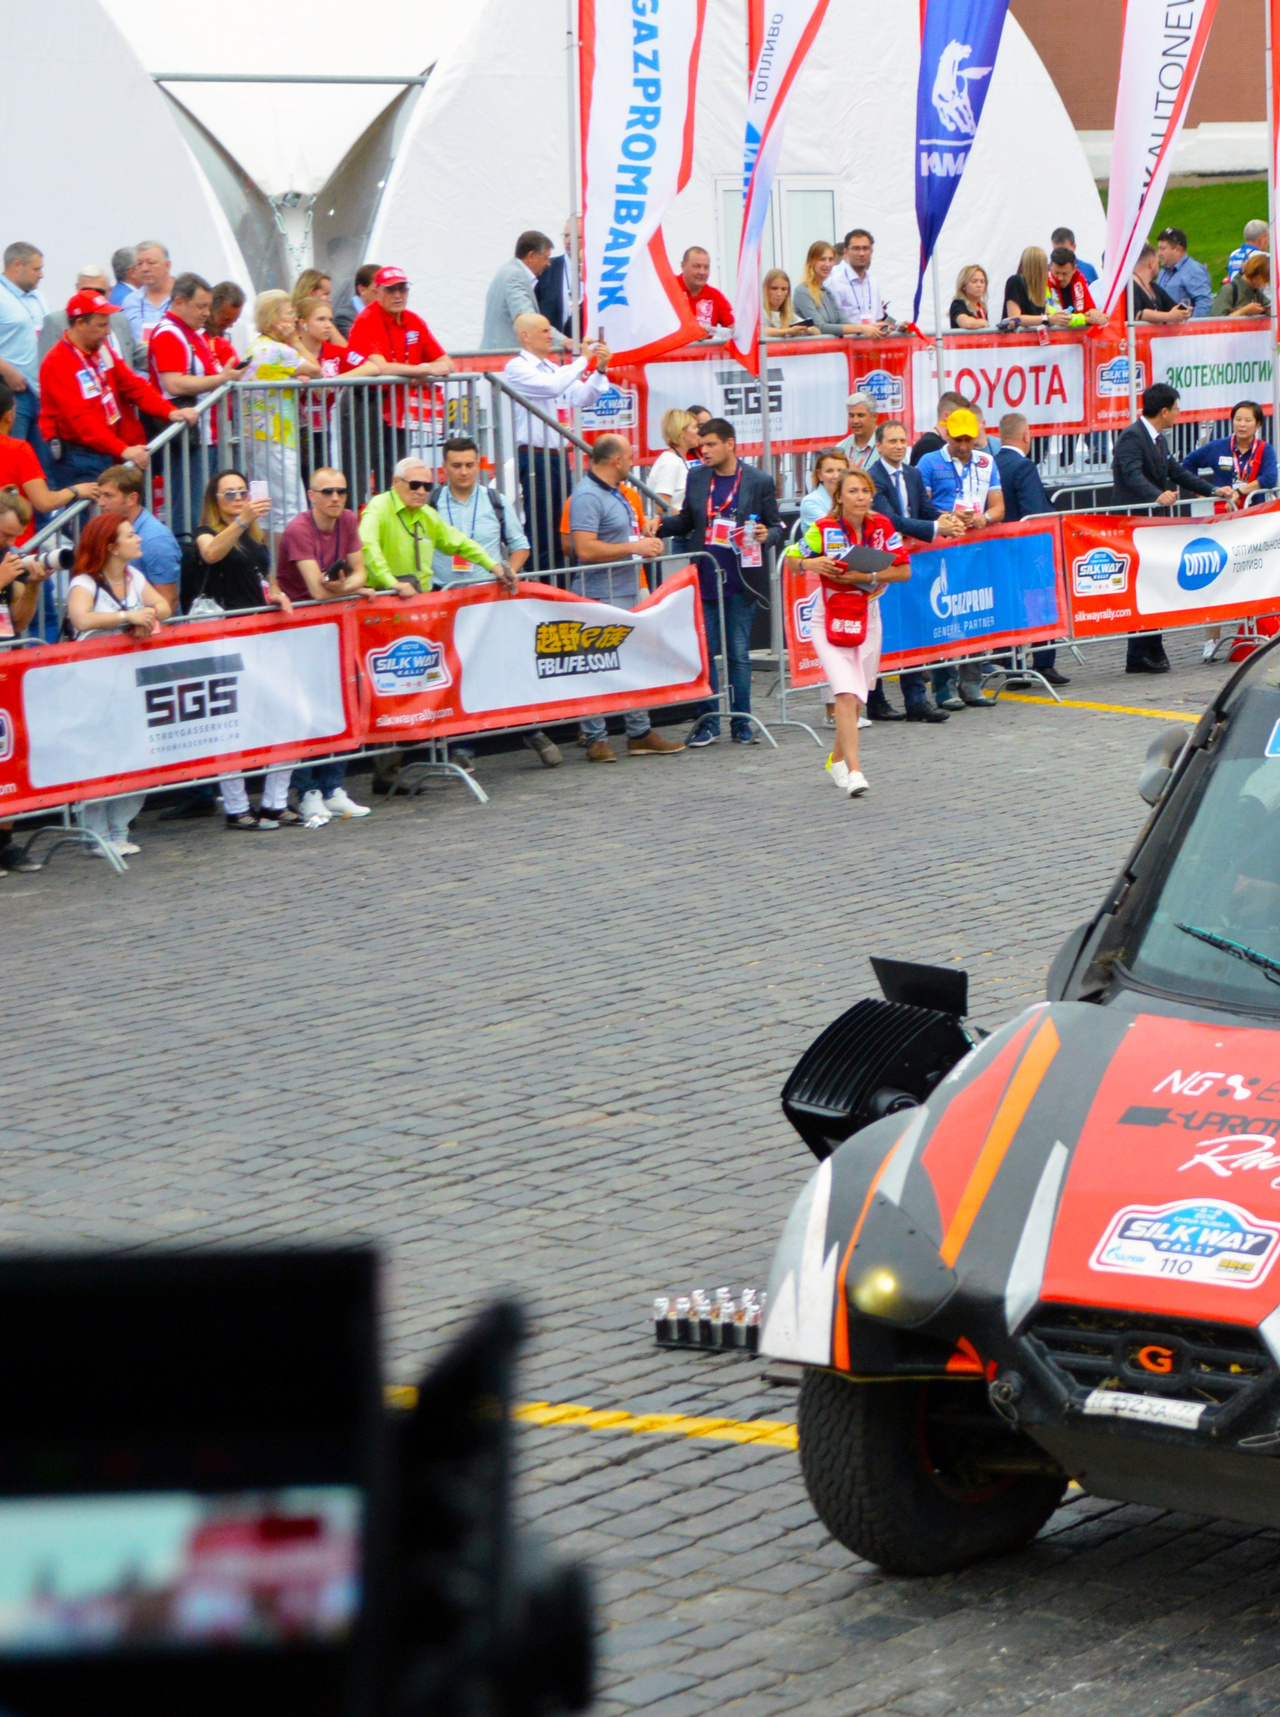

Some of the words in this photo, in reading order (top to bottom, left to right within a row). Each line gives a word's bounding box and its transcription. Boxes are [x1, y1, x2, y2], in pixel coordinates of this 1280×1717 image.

[1079, 564, 1101, 576] SILK
[1101, 562, 1123, 573] WAY
[1184, 551, 1221, 577] ОПТИ
[951, 586, 994, 616] GAZPROM
[1074, 607, 1132, 623] silkwayrally.com
[933, 623, 962, 638] GENERAL
[963, 616, 995, 631] PARTNER
[376, 657, 412, 671] SILK
[412, 653, 438, 667] WAY
[537, 651, 619, 676] FBLIFE.COM
[145, 676, 239, 728] SGS
[376, 707, 454, 727] silkwayrally.com
[1153, 1069, 1225, 1096] NG
[1123, 1220, 1199, 1243] SILK
[1198, 1227, 1266, 1251] WAY
[1157, 1240, 1215, 1256] RALLY
[1159, 1256, 1194, 1276] 110
[1137, 1345, 1173, 1374] G
